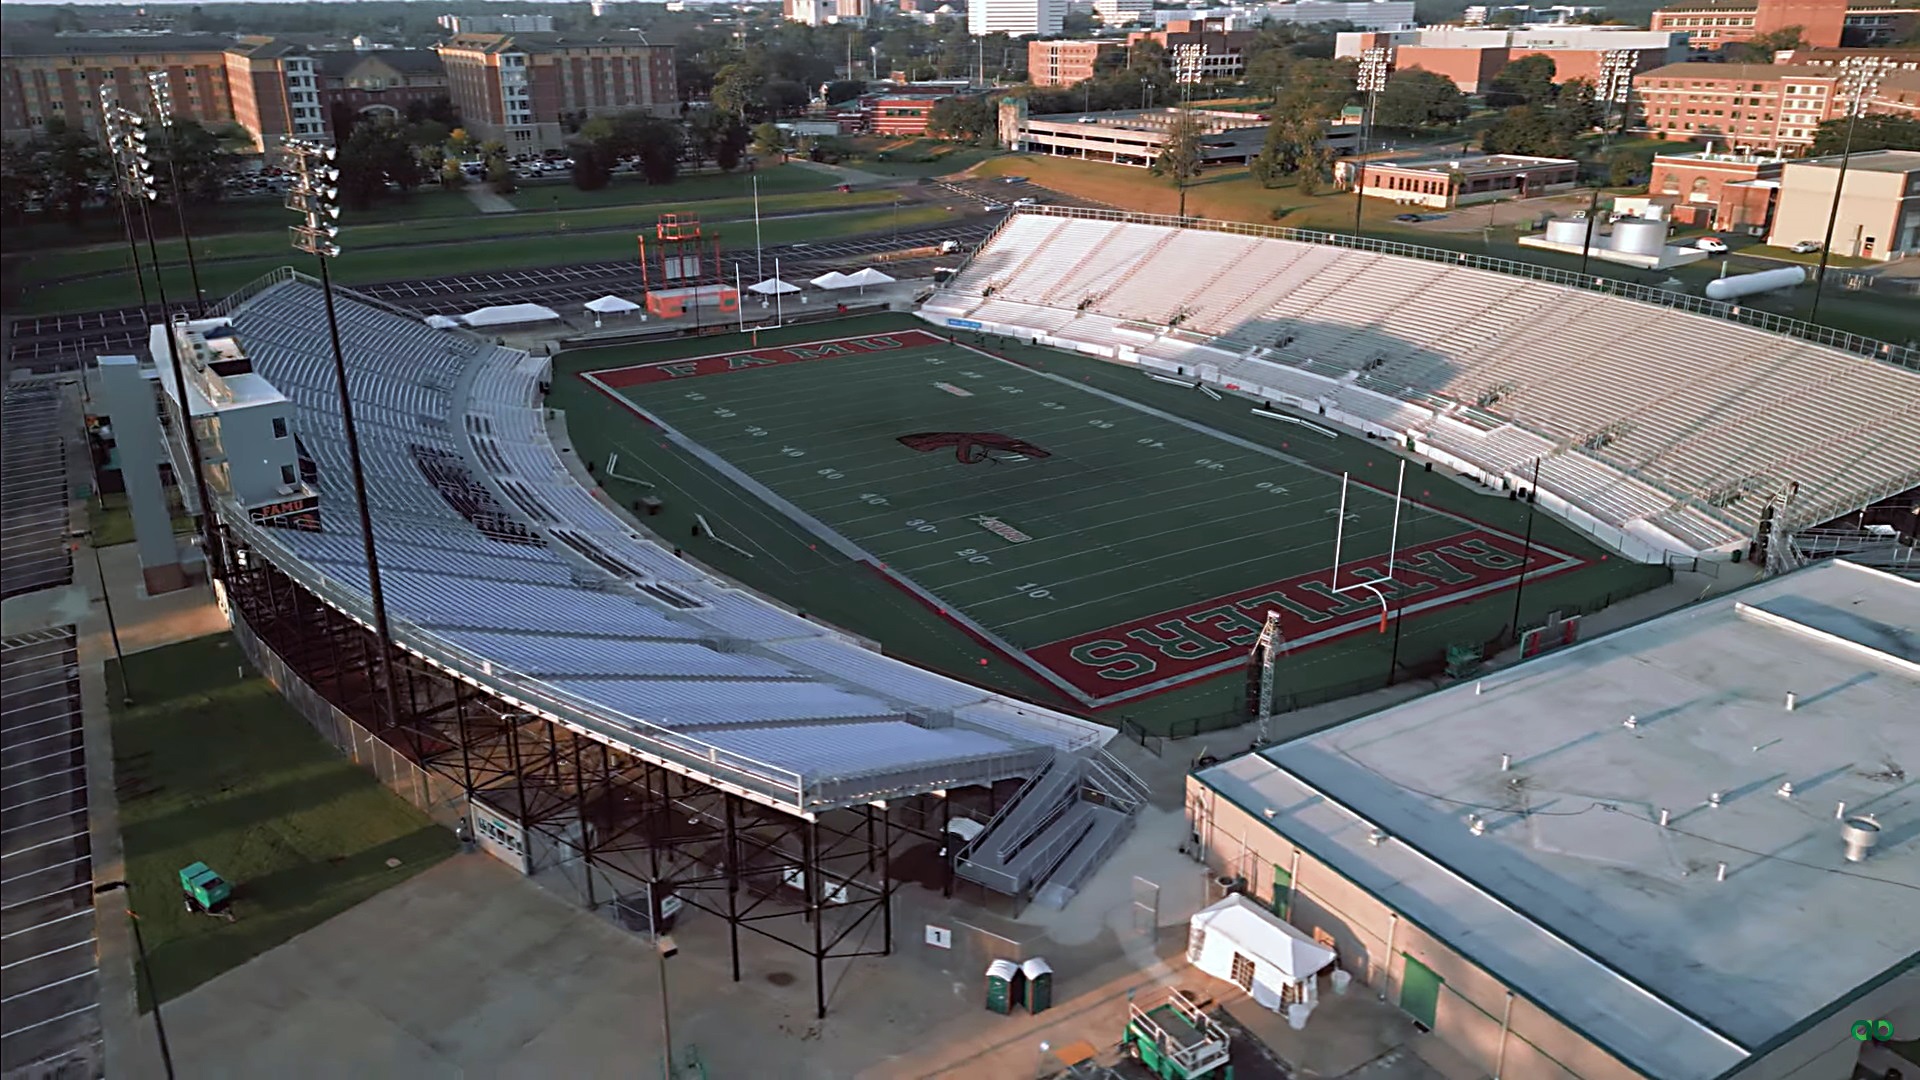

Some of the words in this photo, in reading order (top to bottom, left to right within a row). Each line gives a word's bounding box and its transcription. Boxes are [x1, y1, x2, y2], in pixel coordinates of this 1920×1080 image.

[657, 335, 904, 378] FAMU
[817, 468, 845, 480] 50
[860, 493, 887, 505] 40
[262, 500, 303, 517] FAMU
[905, 518, 936, 532] 30
[955, 548, 990, 563] 20
[1015, 582, 1050, 598] 10
[1070, 538, 1535, 681] RATTLERS
[934, 931, 941, 943] 1
